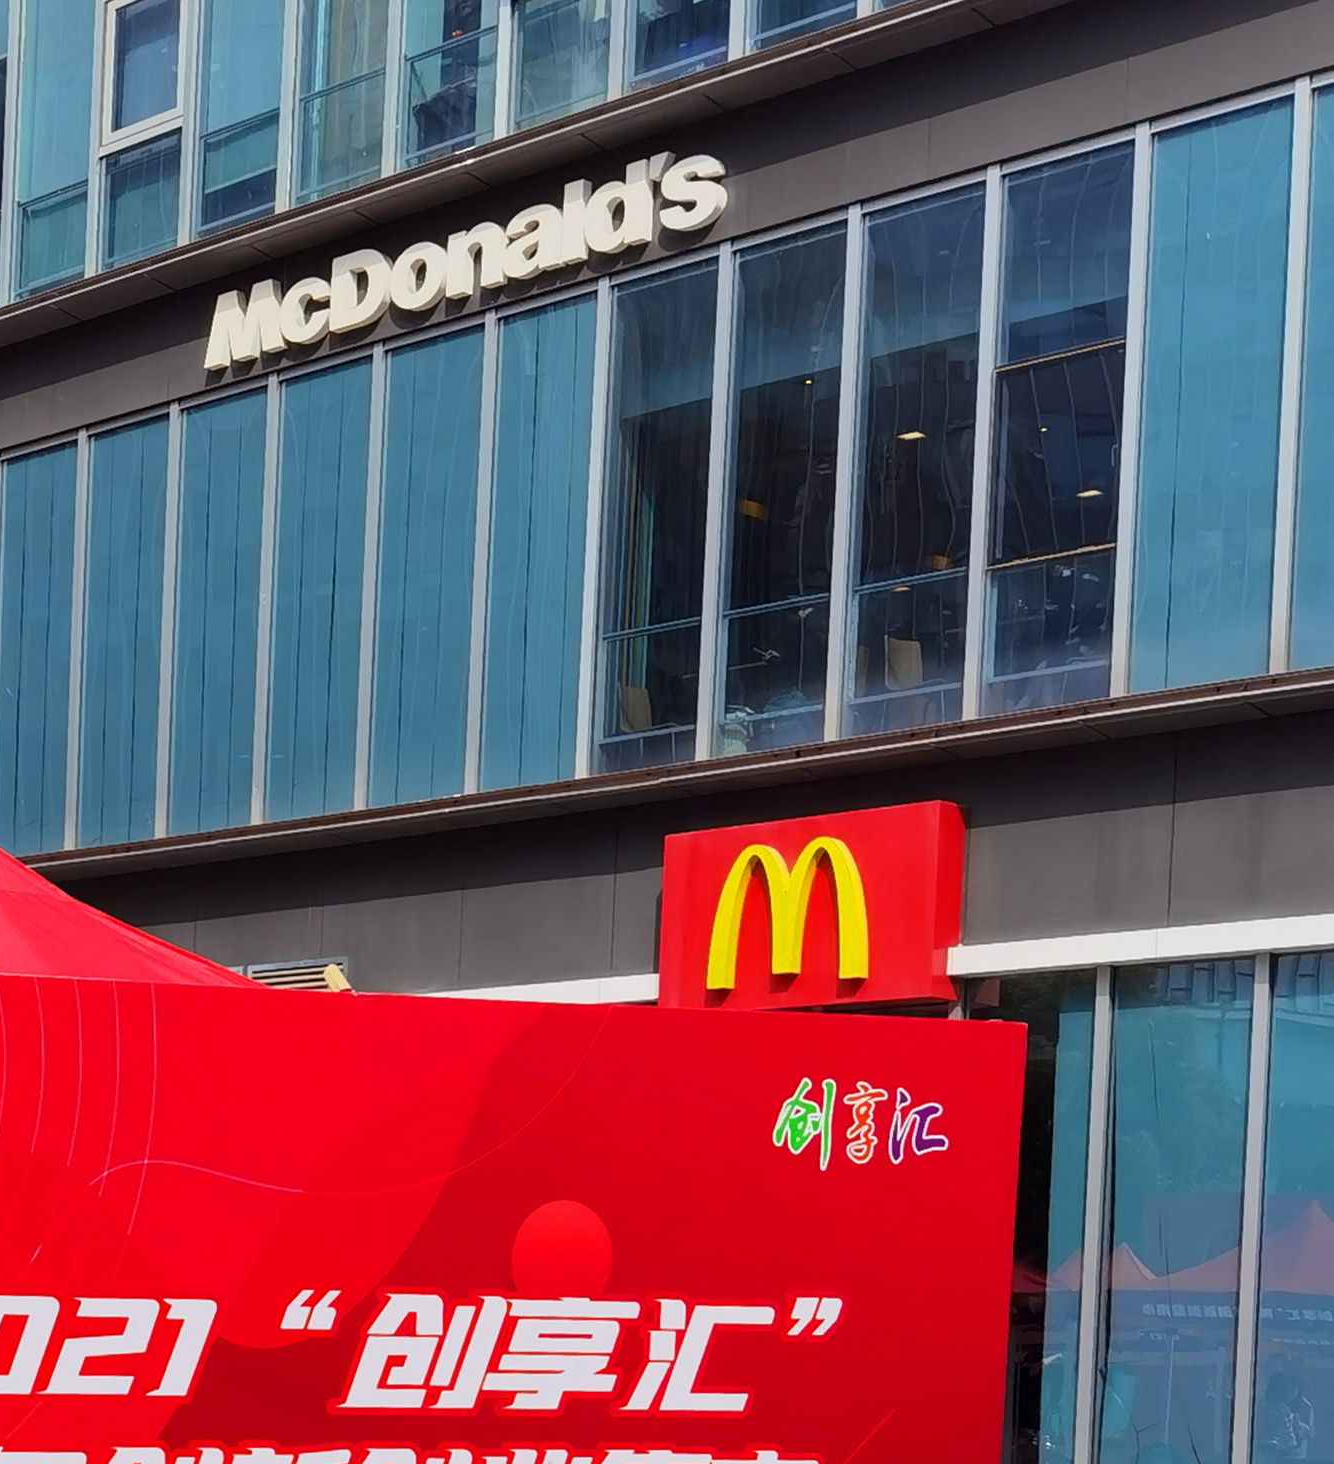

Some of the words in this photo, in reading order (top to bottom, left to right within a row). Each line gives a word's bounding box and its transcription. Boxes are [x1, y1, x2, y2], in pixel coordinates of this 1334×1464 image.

[203, 151, 728, 371] McDonald's
[772, 1077, 949, 1171] 创享汇
